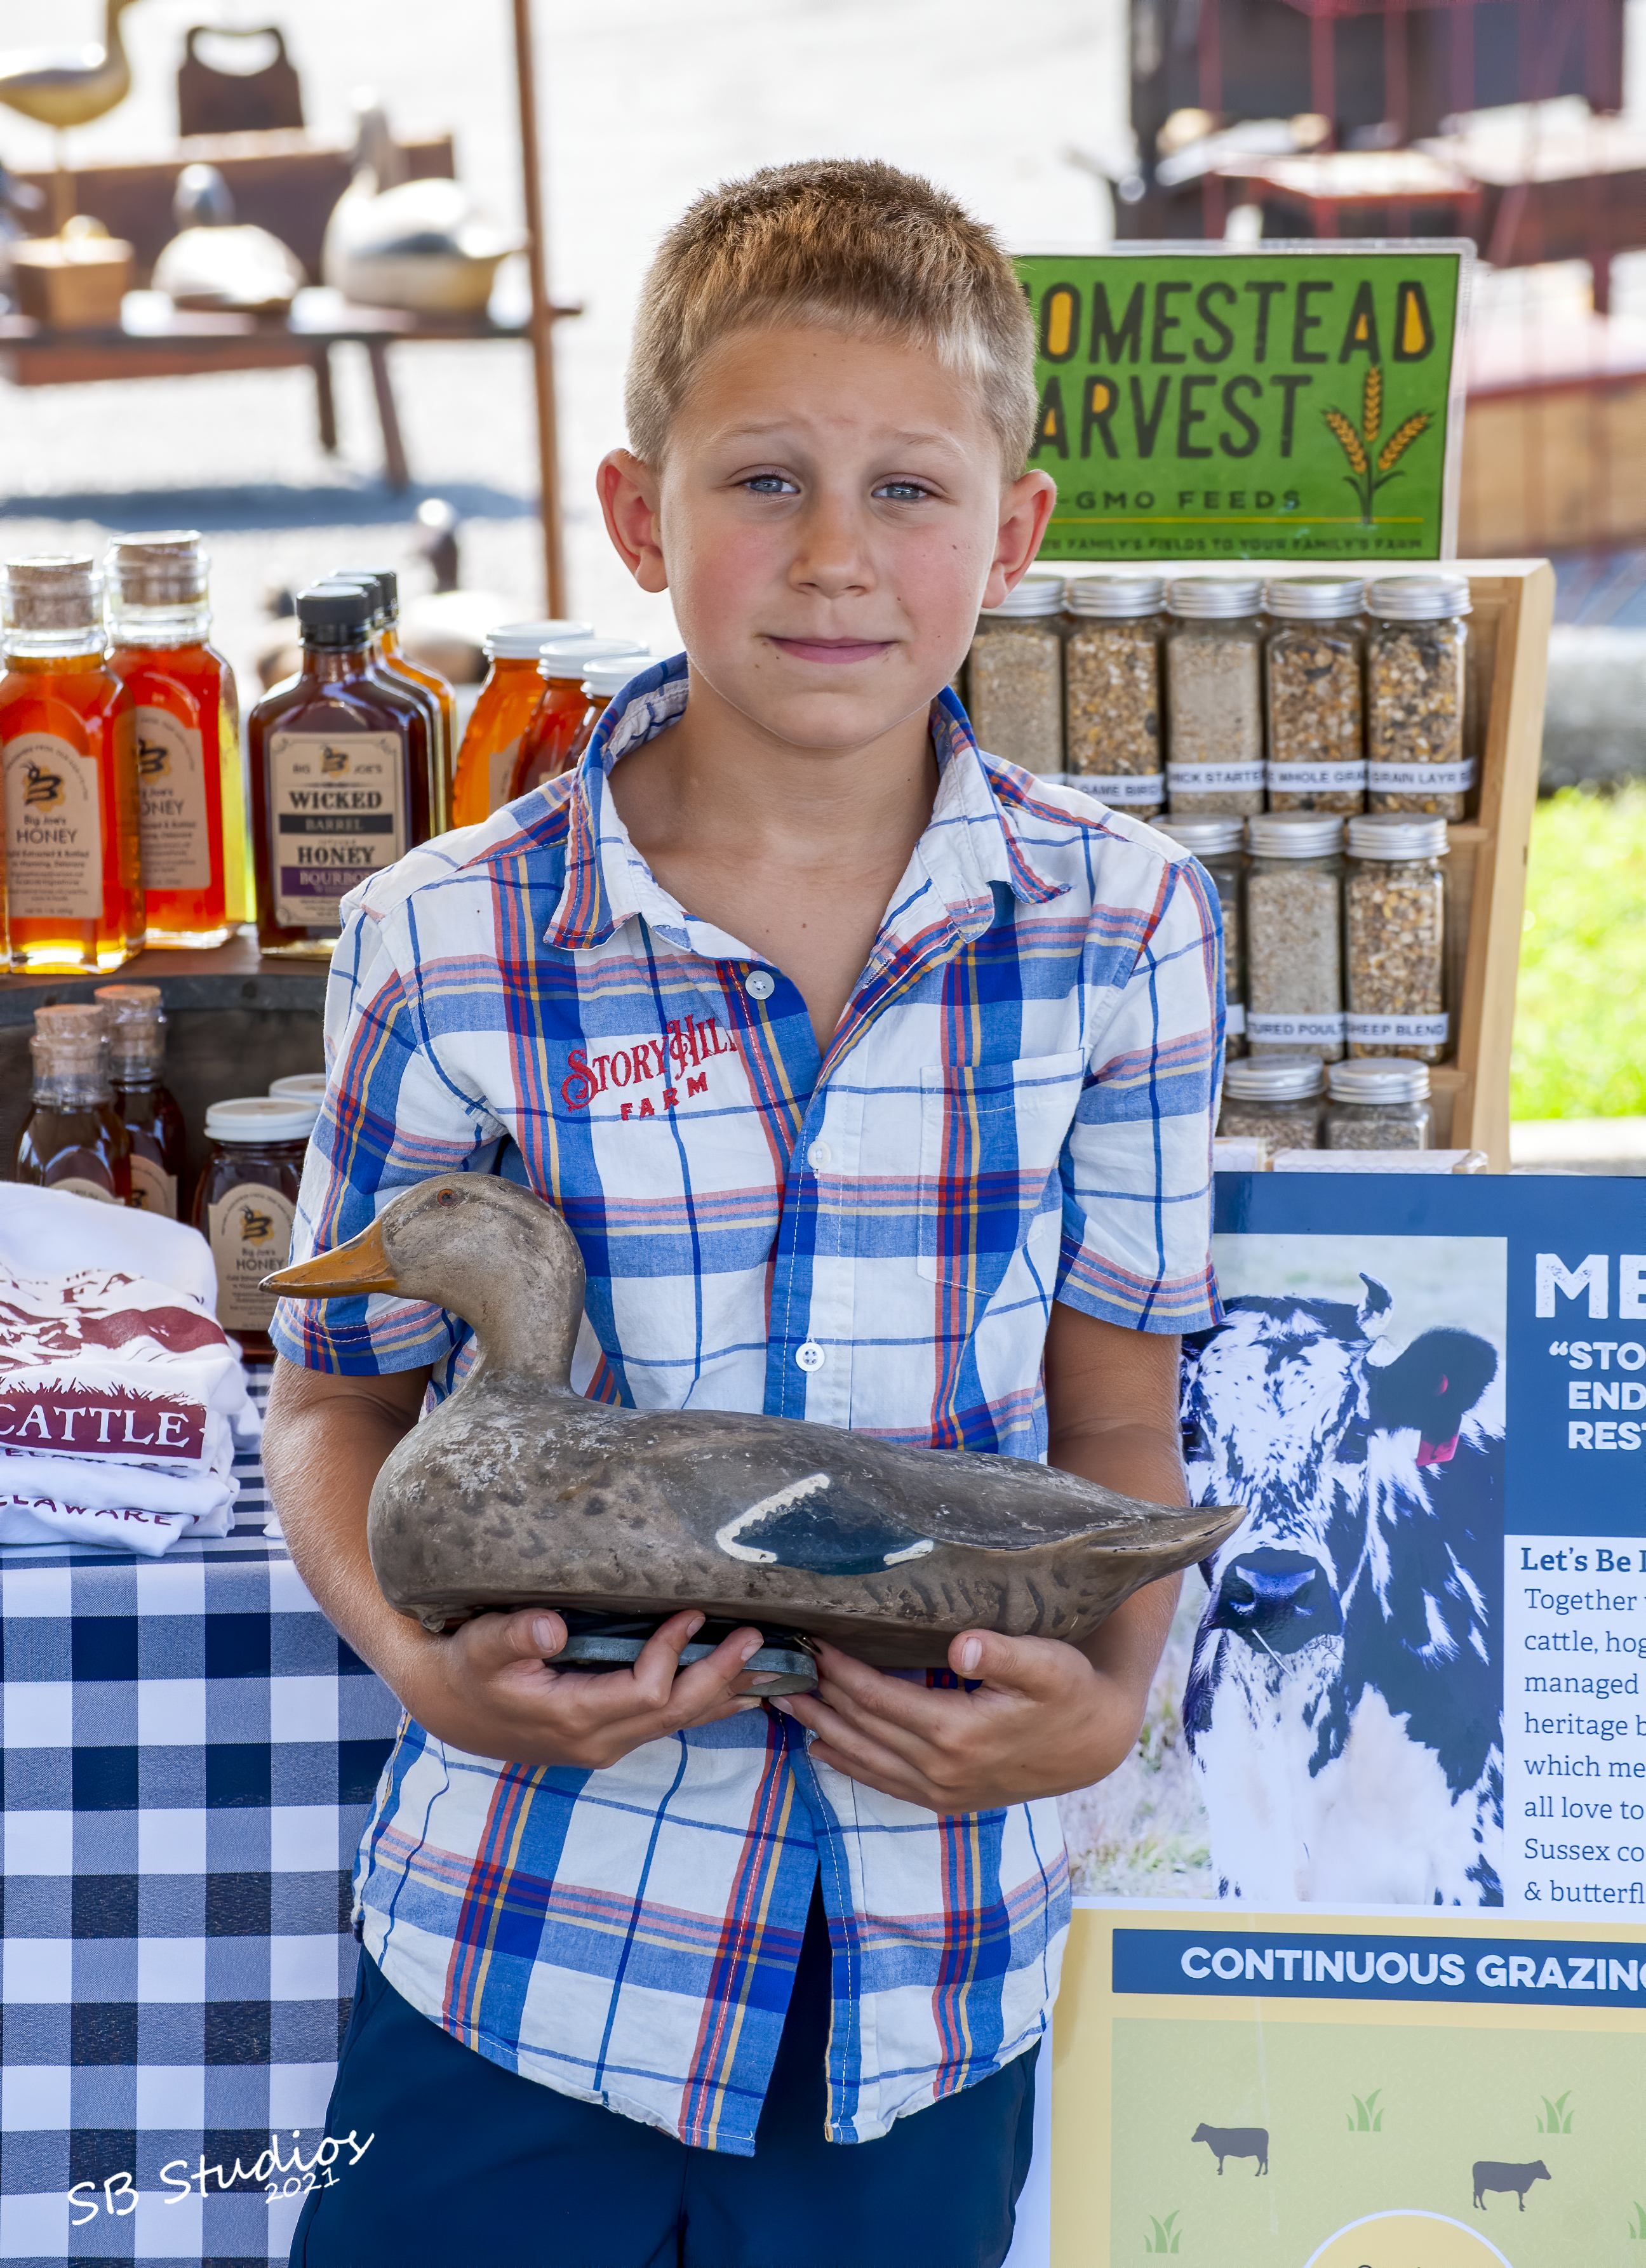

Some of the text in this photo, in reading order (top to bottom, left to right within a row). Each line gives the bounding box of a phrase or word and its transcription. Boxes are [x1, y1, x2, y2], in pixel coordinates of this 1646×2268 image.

[1022, 280, 1435, 364] OMESTEAD
[1177, 489, 1301, 510] FEEDS
[1211, 537, 1234, 552] TO
[292, 764, 311, 775] BIG
[1278, 771, 1330, 784] WHOLE
[288, 790, 383, 810] WICKED
[24, 814, 67, 827] Big Joe's
[305, 817, 364, 832] BARREL
[17, 828, 77, 844] HONEY
[297, 845, 375, 864] HONEY
[1395, 1022, 1446, 1037] BLEND
[620, 1071, 709, 1121] FARM
[236, 1258, 284, 1271] HONEY
[1569, 1381, 1646, 1410] END
[1569, 1420, 1646, 1451] RES
[1521, 1547, 1588, 1571] Let's
[1595, 1549, 1631, 1573] Be
[1524, 1588, 1638, 1615] Together
[1525, 1630, 1598, 1655] cattle,
[1525, 1673, 1639, 1700] managed
[1524, 1712, 1628, 1741] heritage
[1523, 1754, 1646, 1778] which me
[1525, 1796, 1645, 1820] all love to
[1525, 1838, 1645, 1862] Sussex co
[1525, 1881, 1542, 1901] &
[1181, 1946, 1646, 1991] CONTINUOUS GRAZIN
